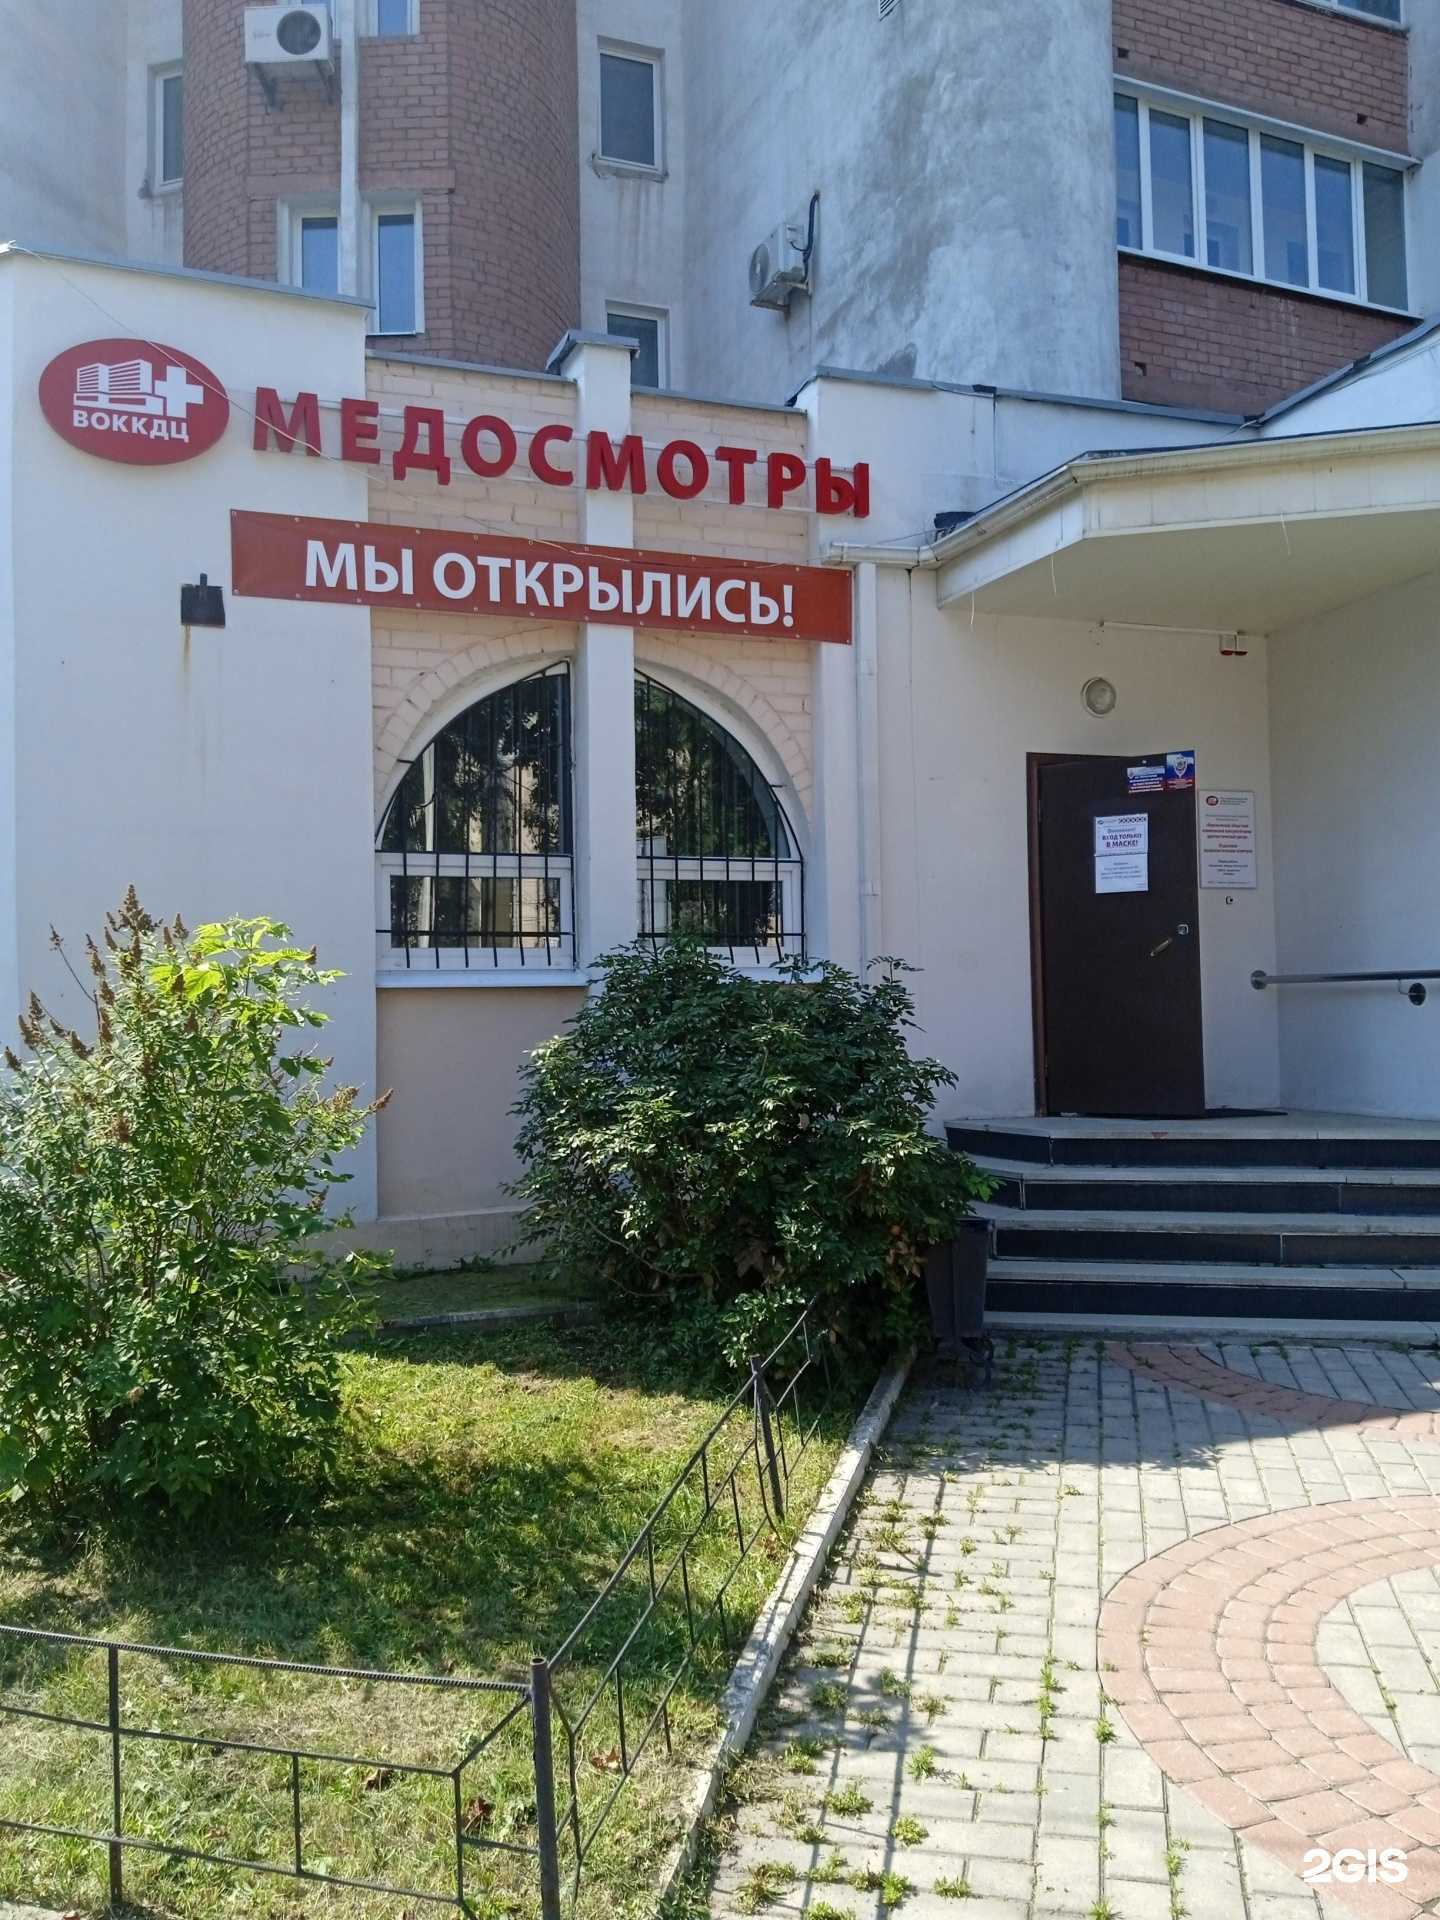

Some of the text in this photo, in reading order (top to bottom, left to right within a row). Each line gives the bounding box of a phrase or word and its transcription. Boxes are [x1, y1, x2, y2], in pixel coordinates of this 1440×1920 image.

[72, 409, 189, 443] ВОККДЦ
[253, 387, 870, 518] МЕДОСМОТРЫ
[305, 540, 794, 627] МЫ ОТКРЫЛИСЬ!
